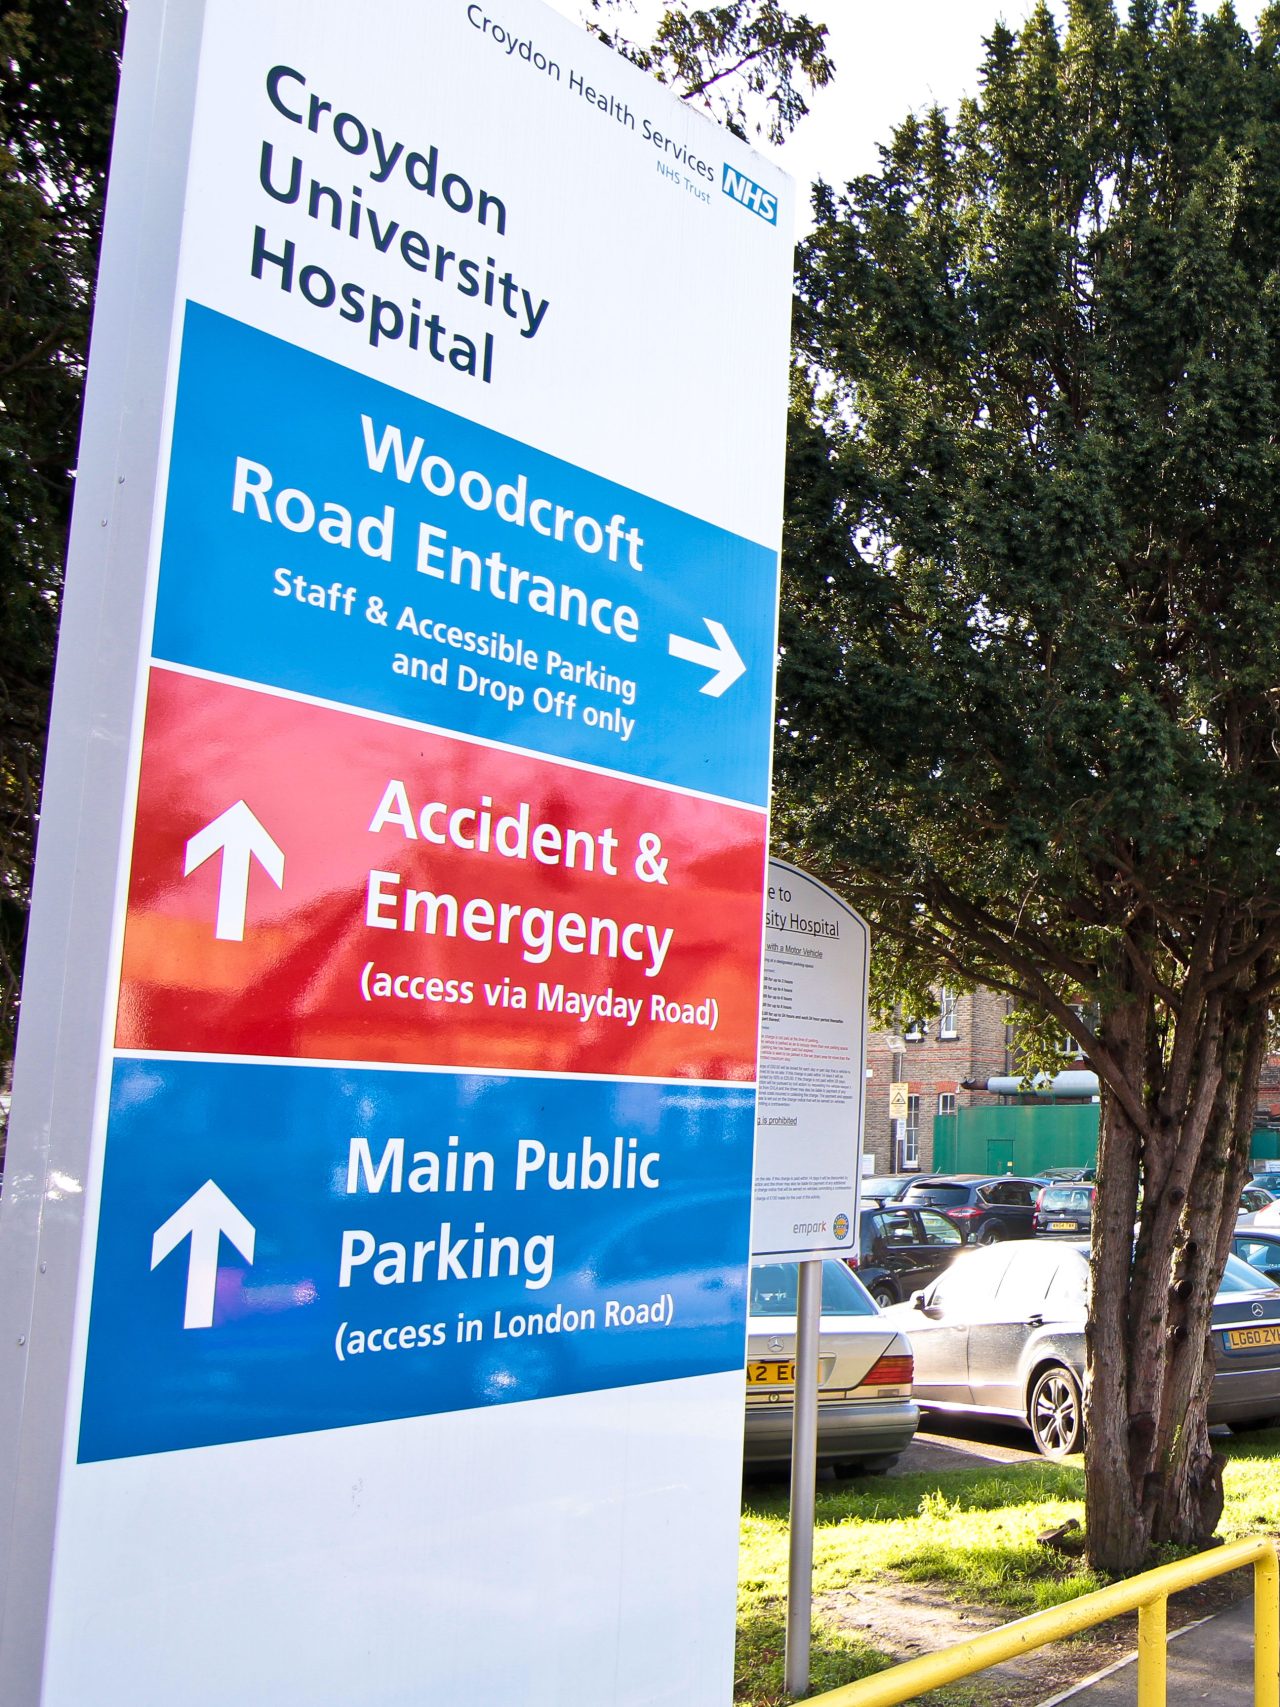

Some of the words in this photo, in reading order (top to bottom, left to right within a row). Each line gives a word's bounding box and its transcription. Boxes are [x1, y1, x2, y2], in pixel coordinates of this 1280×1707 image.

[468, 5, 560, 80] Croydon
[570, 70, 635, 130] Health
[643, 120, 716, 181] Services
[267, 65, 506, 236] Croydon
[656, 160, 681, 184] NHS
[684, 177, 711, 205] Trust
[723, 165, 777, 223] NHS
[259, 140, 550, 339] University
[250, 224, 495, 384] Hospital
[361, 414, 645, 571] Woodcroft
[232, 456, 395, 562] Road
[417, 522, 640, 643] Entrance
[274, 567, 357, 615] Staff
[366, 596, 388, 626] &
[396, 606, 538, 671] Accessible
[546, 650, 637, 705] Parking
[392, 653, 448, 686] and
[458, 664, 525, 711] Drop
[533, 687, 577, 720] Off
[584, 705, 636, 741] only
[368, 779, 618, 876] Accident
[635, 832, 669, 885] &
[366, 869, 674, 977] Emergency
[779, 886, 792, 902] to
[790, 912, 839, 937] Hospital
[767, 943, 778, 952] with
[785, 944, 802, 954] Motor
[803, 947, 823, 959] Vehicle
[361, 961, 475, 1005] (access
[484, 980, 527, 1009] via
[538, 982, 643, 1026] Mayday
[651, 994, 719, 1030] Road)
[769, 1117, 797, 1125] prohibited
[346, 1136, 494, 1194] Main
[516, 1136, 660, 1191] Public
[339, 1222, 555, 1290] Parking
[793, 1221, 826, 1236] empark
[335, 1320, 446, 1361] (access
[456, 1315, 483, 1343] in
[494, 1303, 596, 1339] London
[605, 1293, 674, 1327] Road)
[1230, 1330, 1261, 1346] LG60
